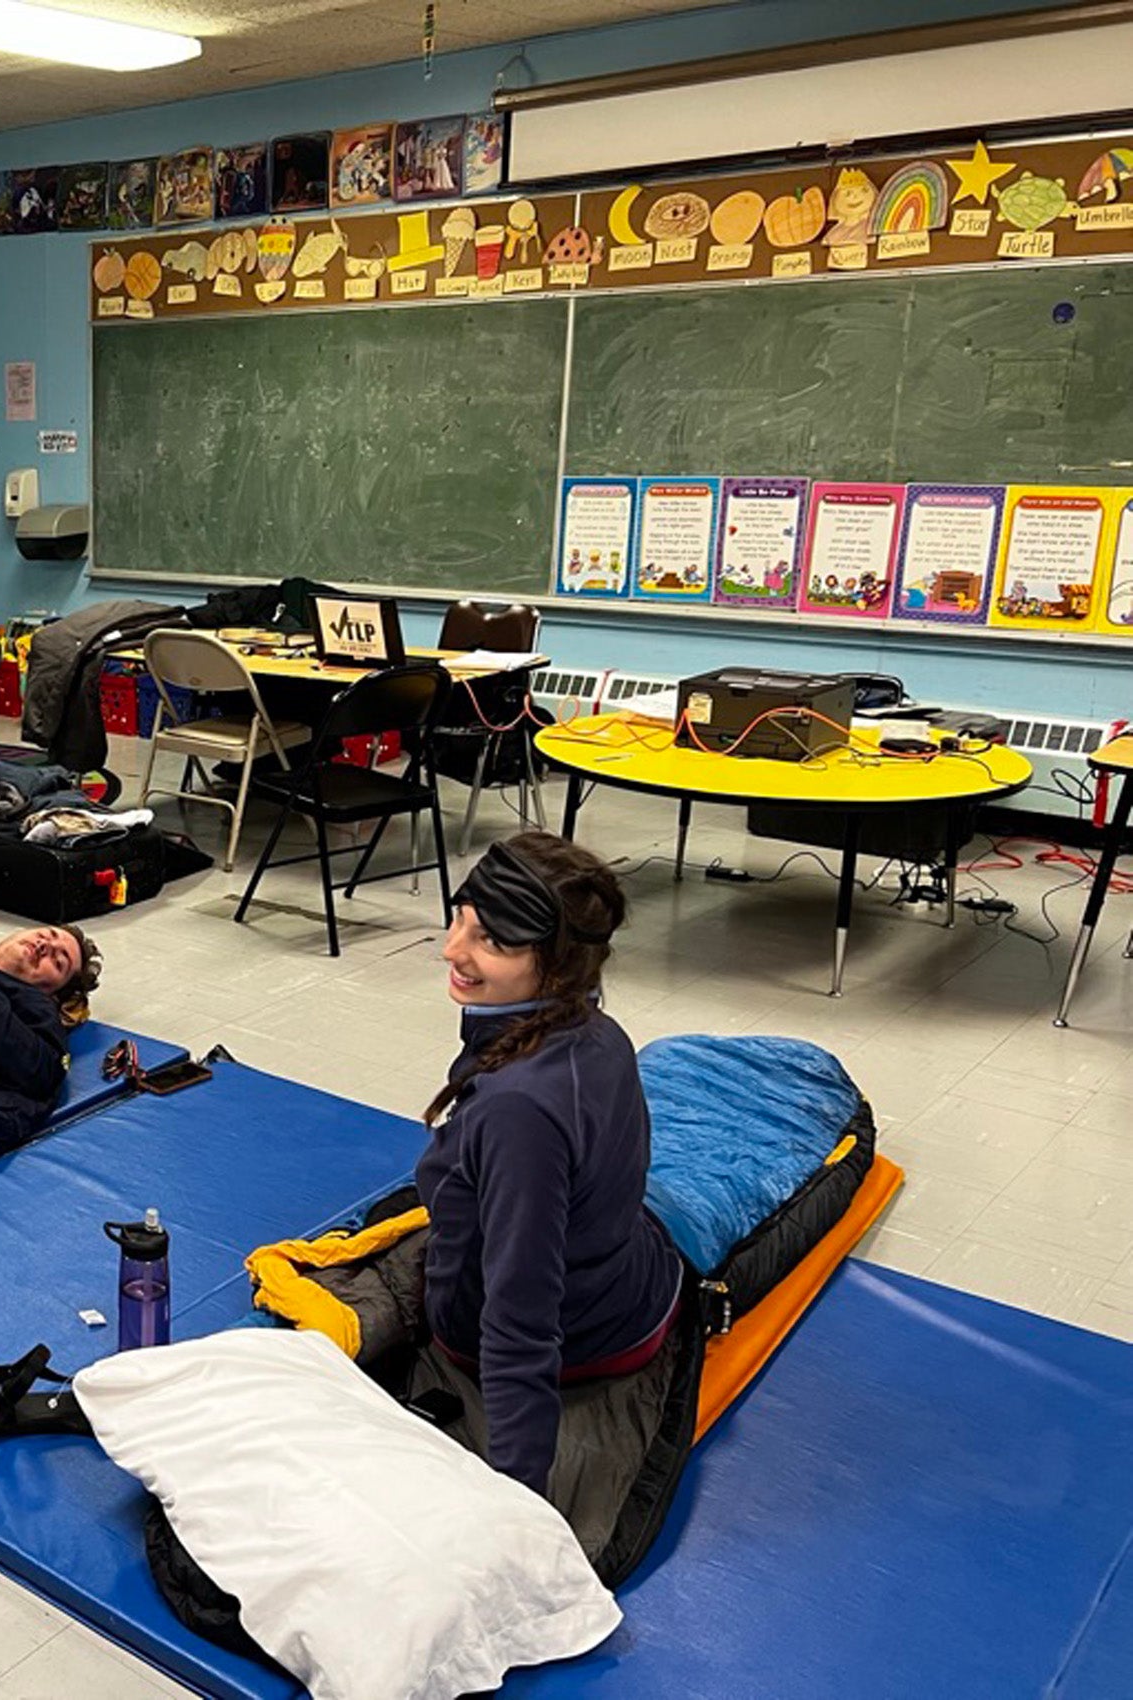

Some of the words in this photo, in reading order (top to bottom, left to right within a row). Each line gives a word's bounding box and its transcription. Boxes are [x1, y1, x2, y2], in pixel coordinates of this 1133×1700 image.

[954, 213, 986, 232] Star
[661, 243, 692, 259] Nest
[881, 238, 928, 253] Rainbow
[1006, 234, 1050, 253] Turtle
[397, 276, 420, 289] Hat
